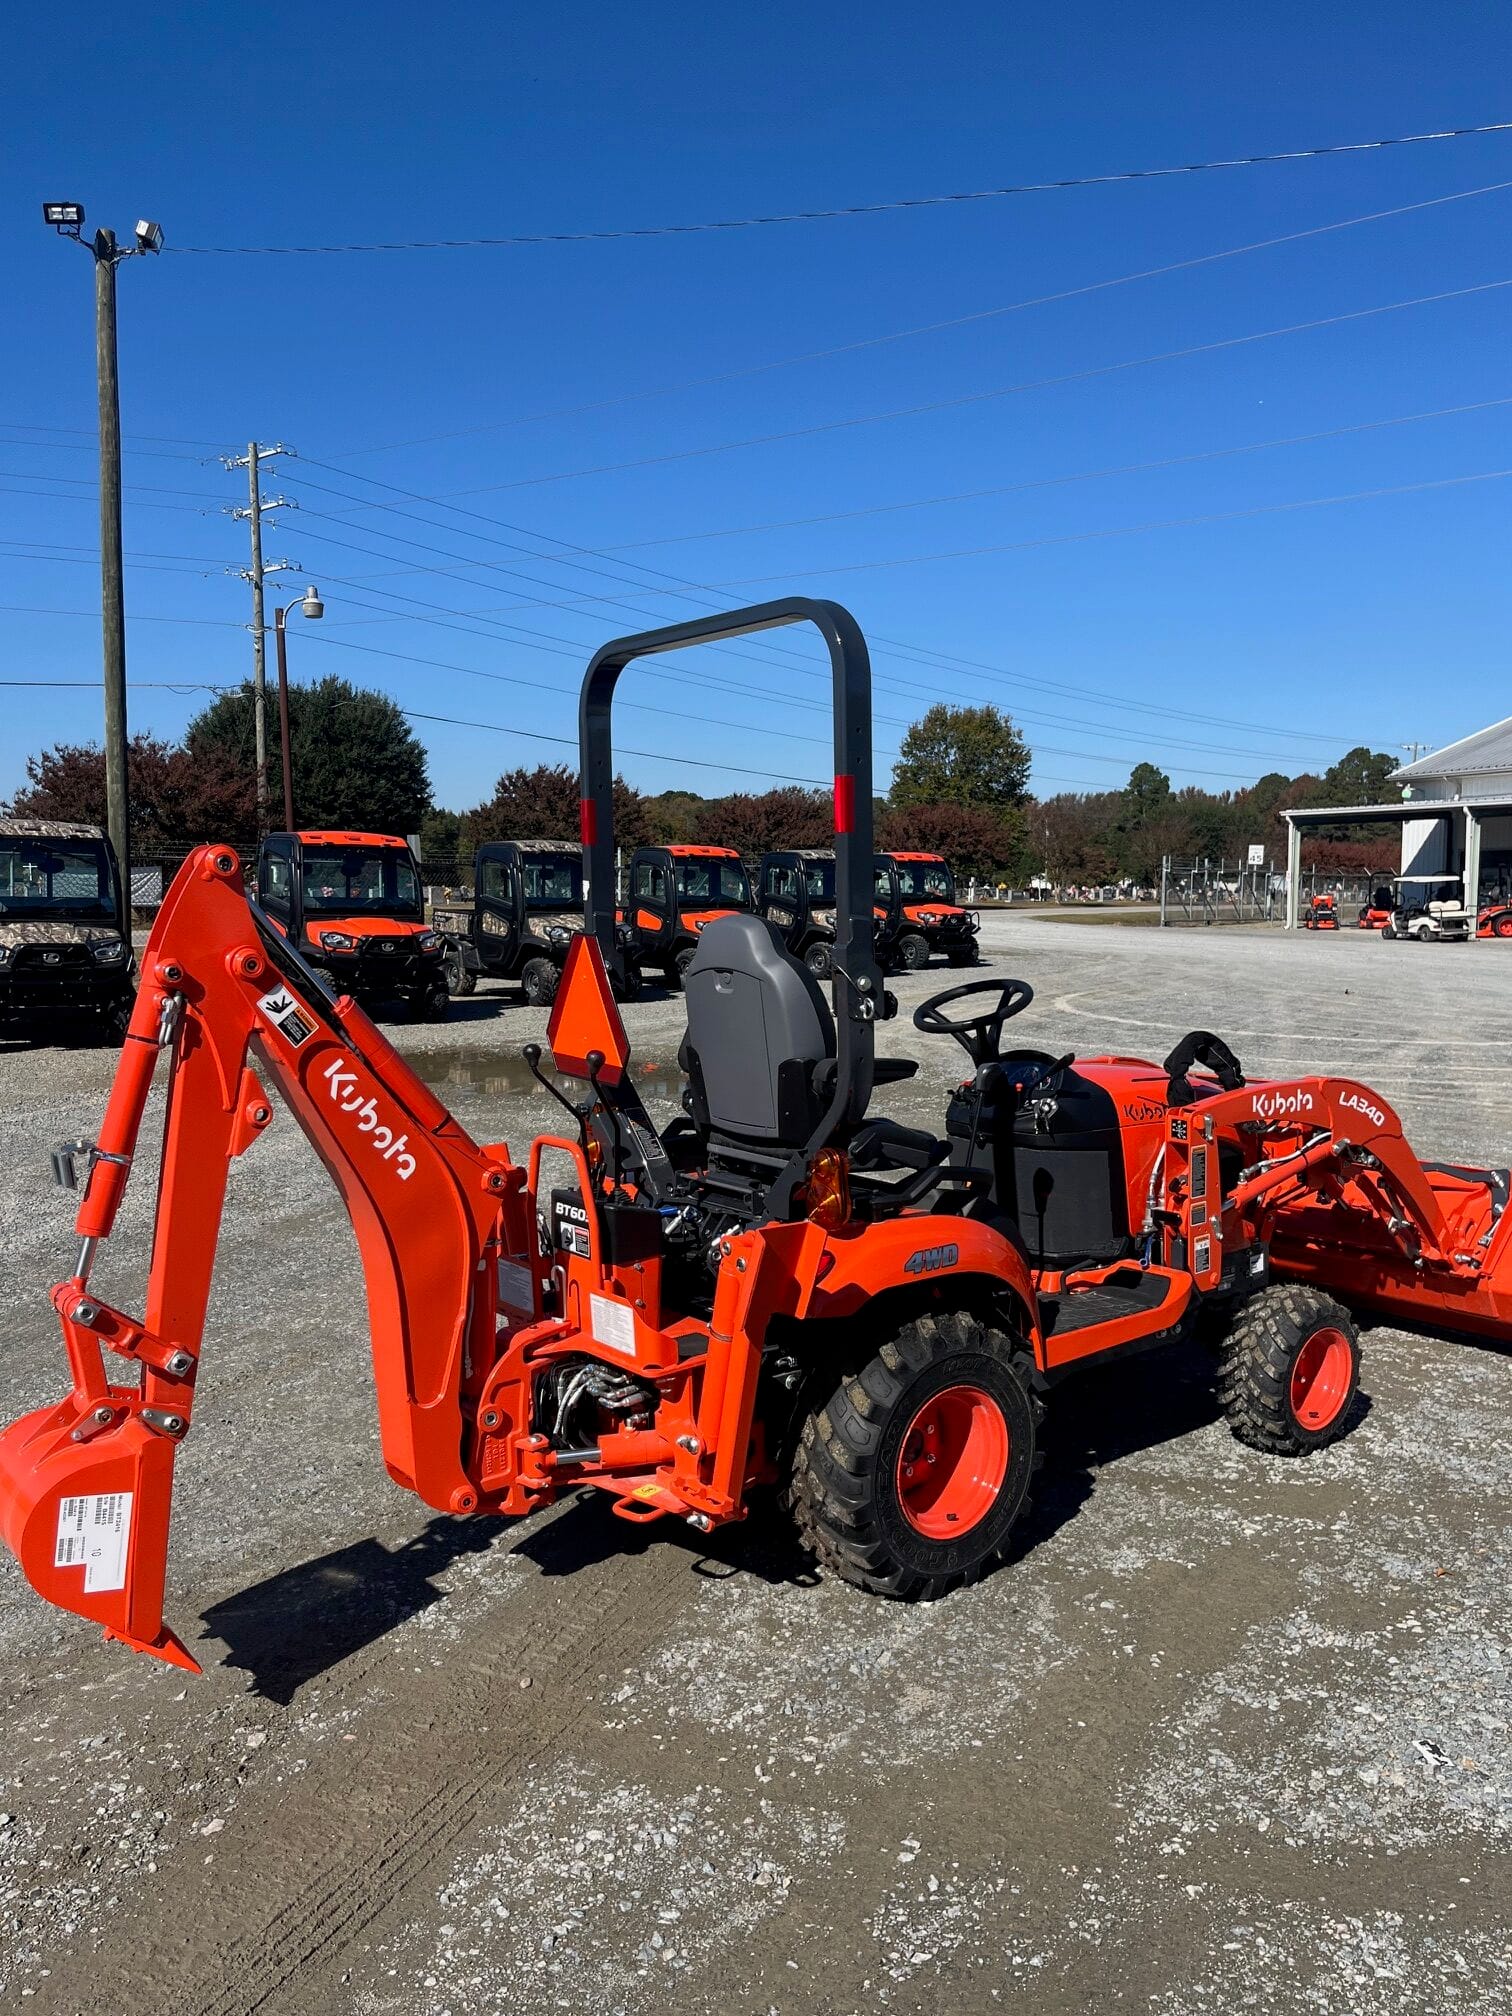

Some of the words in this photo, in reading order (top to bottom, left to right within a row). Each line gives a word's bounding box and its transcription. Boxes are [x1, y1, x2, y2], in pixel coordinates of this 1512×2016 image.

[1252, 1088, 1313, 1117] Kubota
[1338, 1091, 1385, 1127] LA340
[323, 1058, 416, 1180] Kubota
[555, 1201, 589, 1223] BT60
[904, 1243, 959, 1274] 4WD
